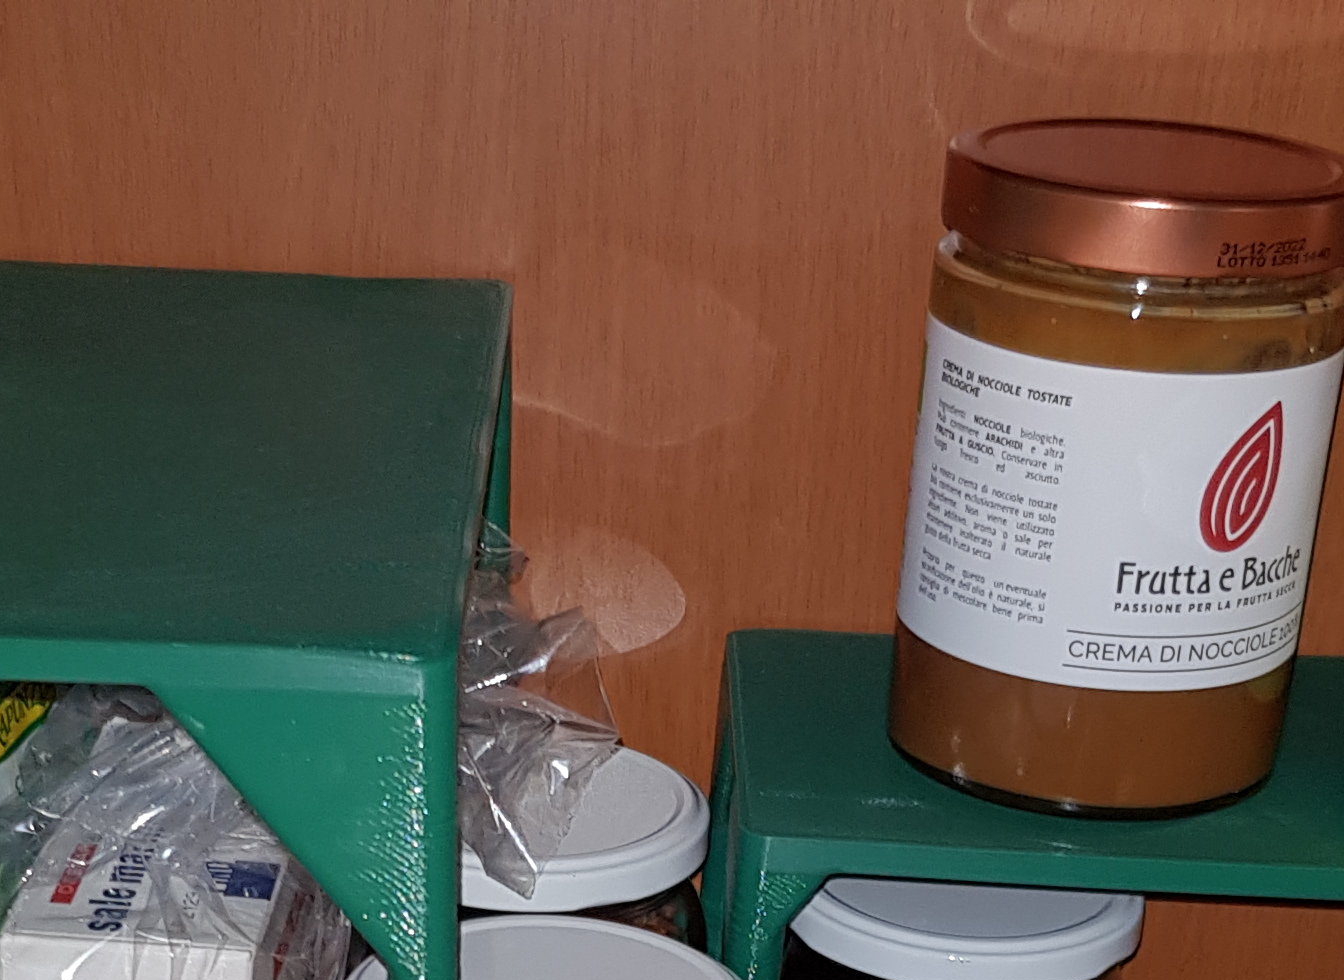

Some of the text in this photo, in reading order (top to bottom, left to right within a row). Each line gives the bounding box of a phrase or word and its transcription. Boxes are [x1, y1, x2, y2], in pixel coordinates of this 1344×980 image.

[1217, 255, 1266, 269] LOTTO
[942, 358, 1073, 407] CREMA DI NOCCIOLE TOSTATE
[973, 414, 1012, 435] NOCCIOLE
[1001, 450, 1048, 470] Conservare
[1054, 462, 1063, 473] in
[1043, 446, 1065, 460] altra
[987, 512, 1055, 537] viene utilizzato
[1023, 509, 1034, 519] un
[1038, 512, 1057, 524] solo
[1014, 533, 1032, 545] sale
[1038, 539, 1054, 551] per
[1015, 547, 1052, 563] naturale
[1116, 545, 1302, 595] Frutta e Bacche
[1114, 602, 1182, 614] PASSIONE
[1188, 601, 1212, 613] PER
[1217, 599, 1232, 610] LA
[1236, 590, 1273, 609] FRUTTA
[1017, 611, 1044, 625] prima
[1067, 627, 1278, 664] CREMA DI NOCCIOLE
[88, 887, 137, 932] sale
